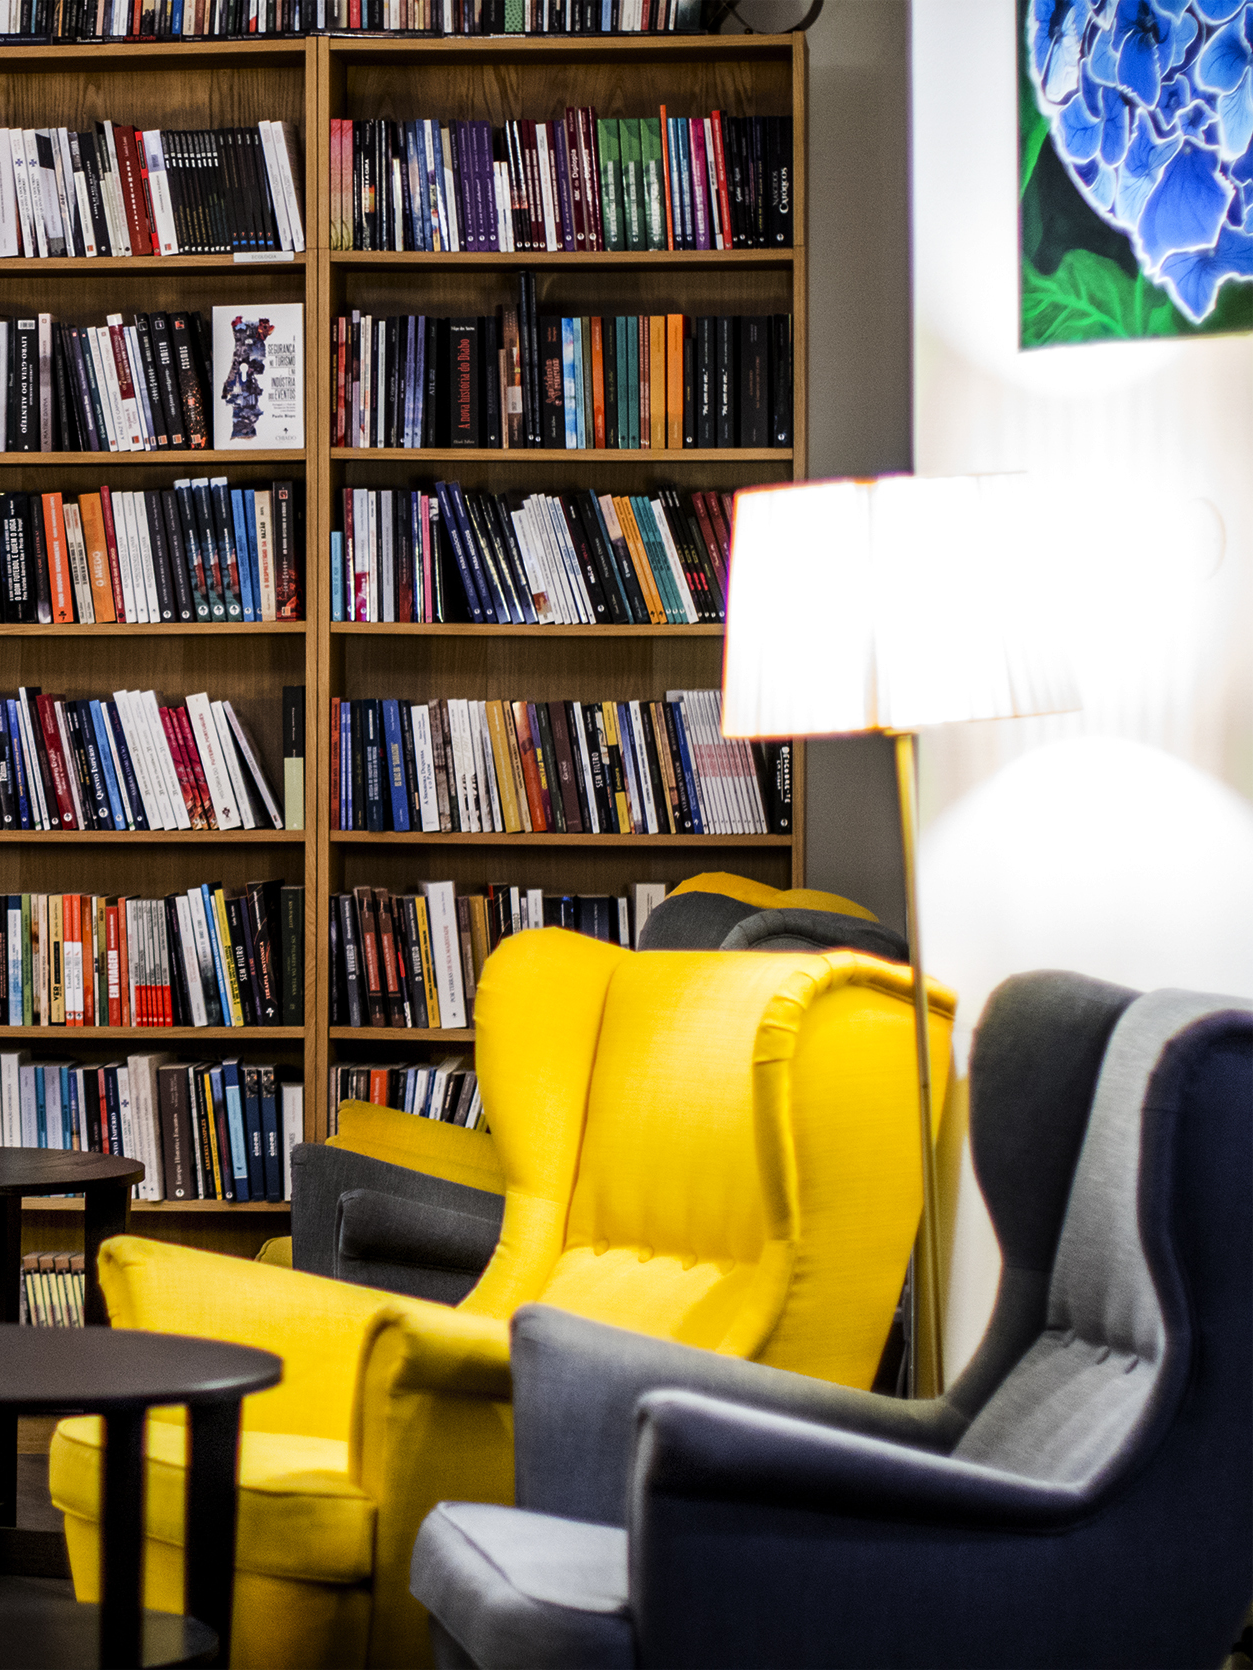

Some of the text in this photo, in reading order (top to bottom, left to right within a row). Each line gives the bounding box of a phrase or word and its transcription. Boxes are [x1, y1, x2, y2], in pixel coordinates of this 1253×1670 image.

[778, 167, 789, 213] CATÓLICOS
[159, 342, 170, 364] COMETA
[180, 346, 190, 369] COSMOS
[268, 344, 295, 354] SEGURANÇA
[275, 356, 295, 366] TURISMO
[458, 339, 471, 360] Diabo
[458, 362, 471, 372] do
[21, 382, 27, 393] DO
[272, 376, 295, 387] INDÚSTRIA
[458, 374, 471, 403] história
[459, 404, 471, 422] nova
[53, 541, 62, 572] NOVAMENTE
[93, 552, 103, 577] MEDO
[56, 574, 64, 592] MUDOU
[88, 745, 104, 800] QUINTO IMPÉRIO
[591, 752, 603, 787] SEM FILTRO
[614, 768, 622, 790] Embora
[236, 946, 247, 981] SEM FILTRO
[259, 941, 271, 999] TERAPIA SINTÓNICA
[345, 945, 356, 972] VIVEIRO
[108, 950, 119, 998] EM VIAGEM
[203, 1145, 211, 1170] SABERES
